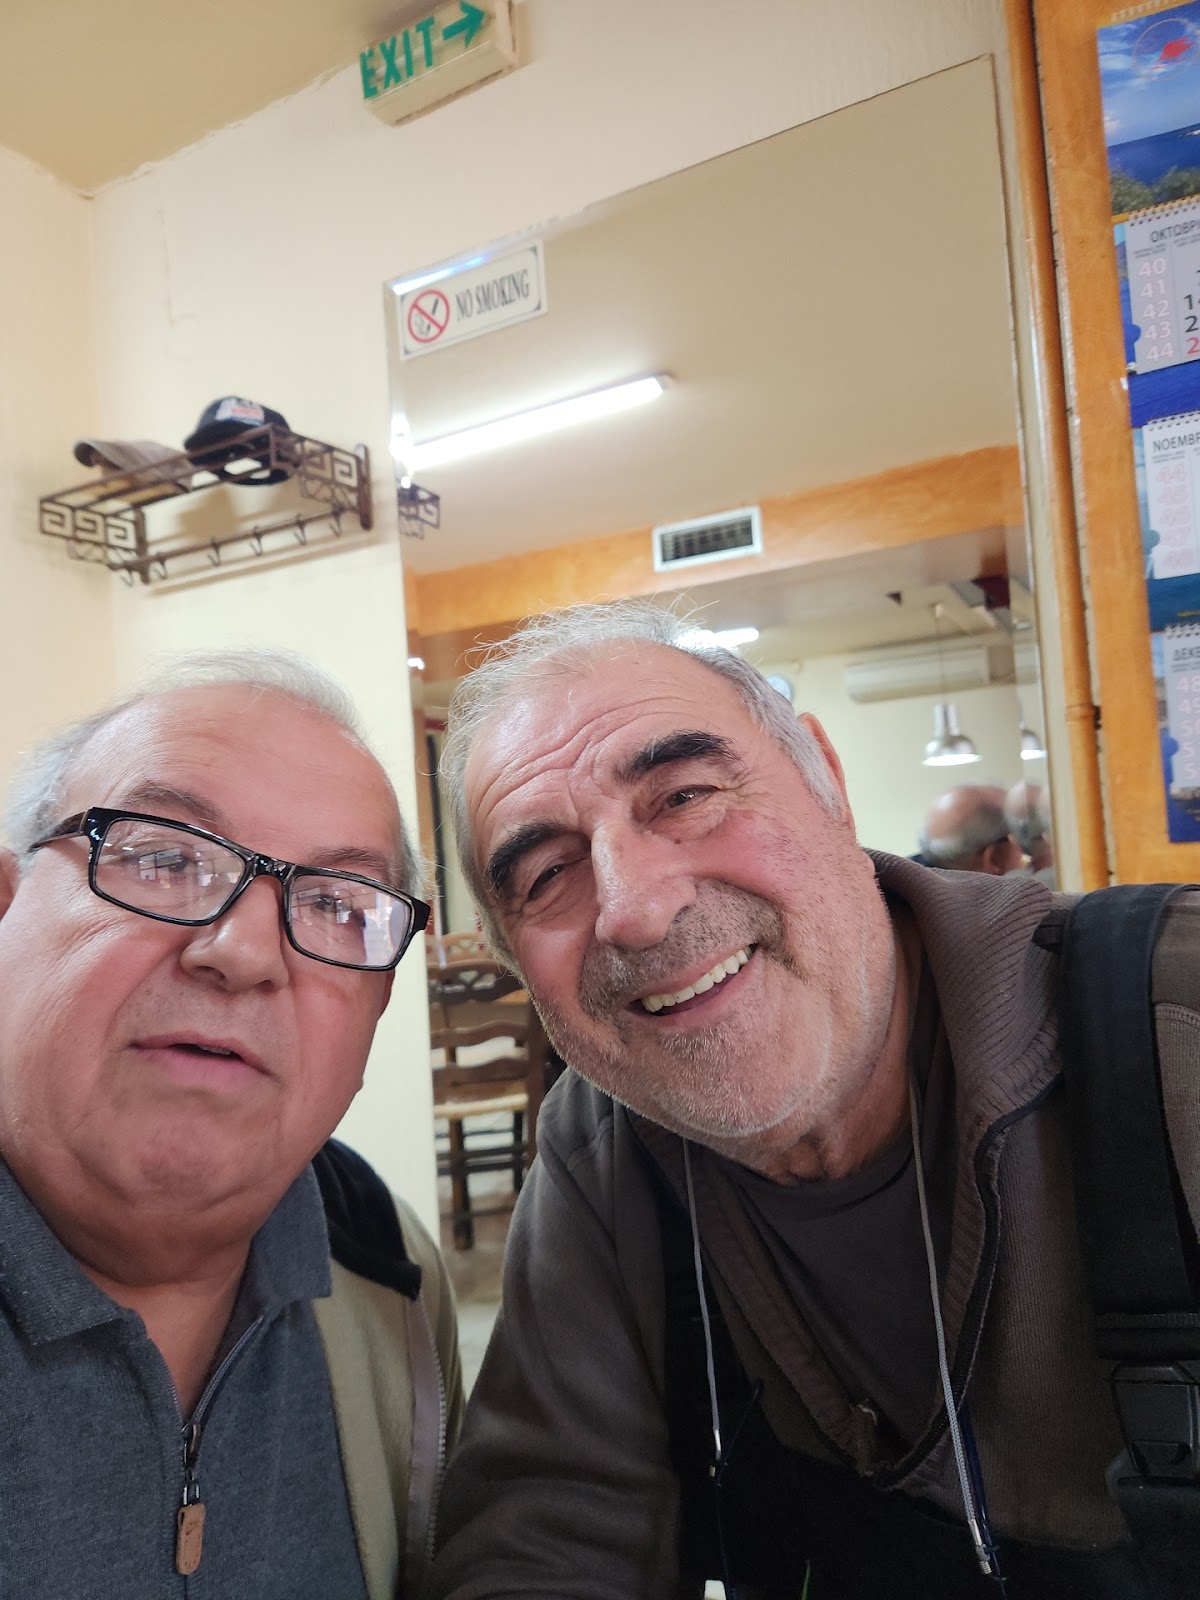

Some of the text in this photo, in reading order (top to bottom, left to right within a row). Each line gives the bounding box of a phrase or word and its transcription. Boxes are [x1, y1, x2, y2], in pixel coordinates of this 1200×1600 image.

[359, 15, 435, 100] EXIT
[1138, 257, 1166, 277] 40
[455, 268, 530, 322] NO SMOKING
[1140, 279, 1166, 298] 41
[1143, 293, 1200, 319] 42 1
[1145, 321, 1171, 341] 43
[1146, 343, 1174, 362] 44
